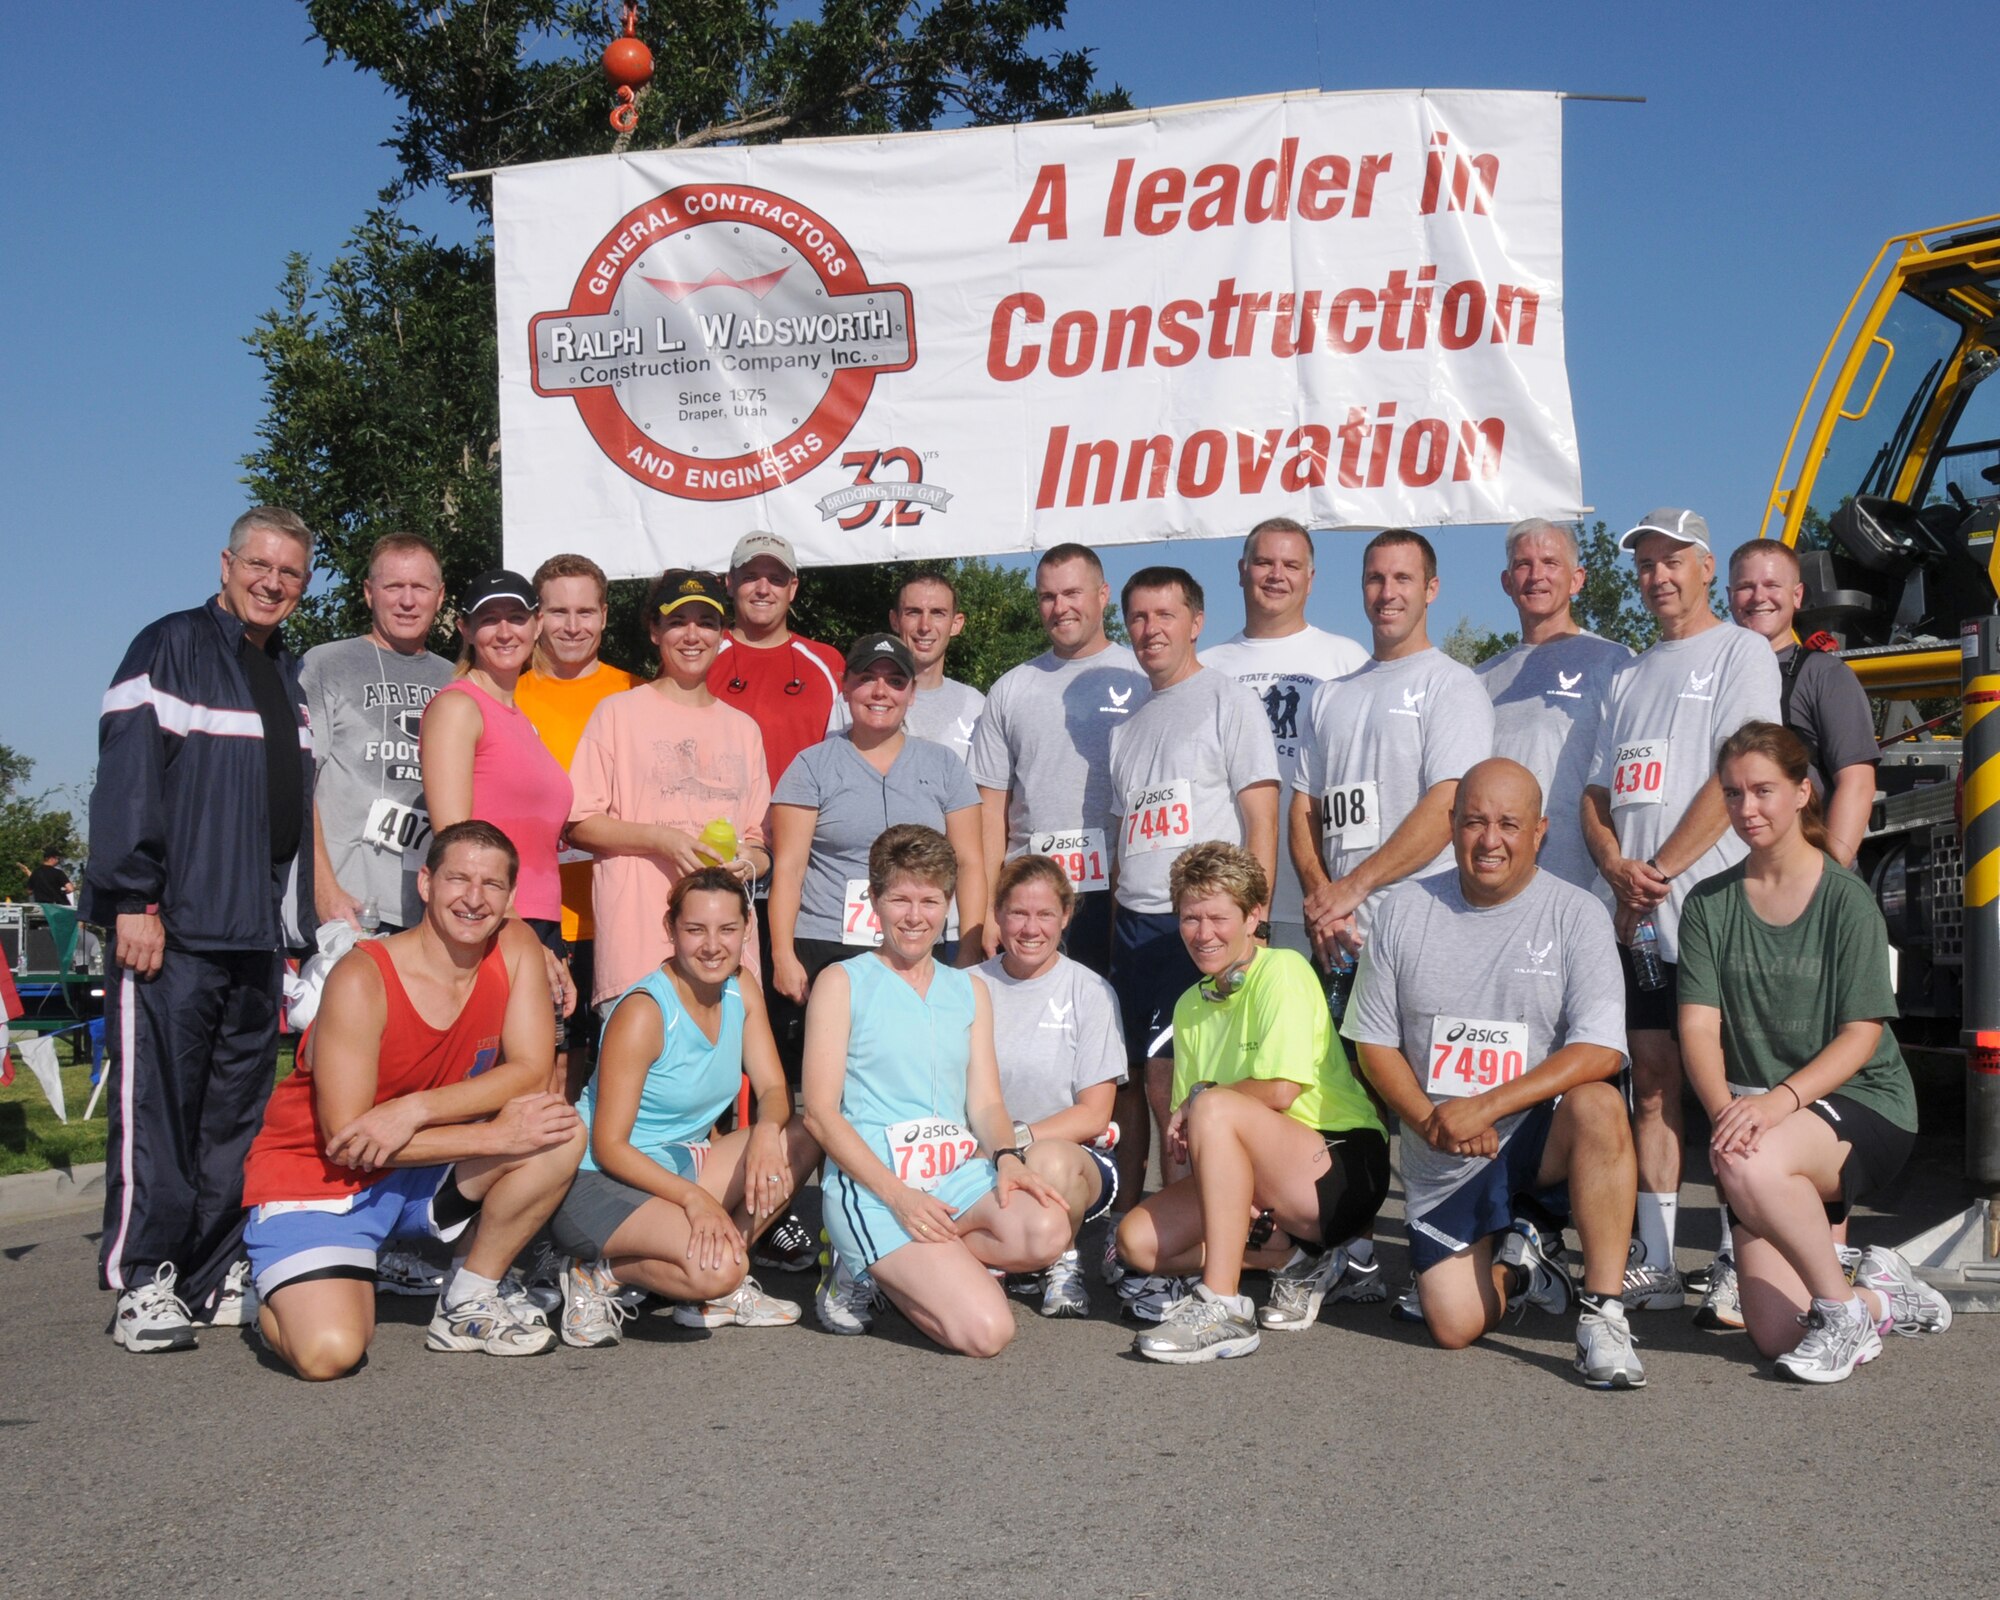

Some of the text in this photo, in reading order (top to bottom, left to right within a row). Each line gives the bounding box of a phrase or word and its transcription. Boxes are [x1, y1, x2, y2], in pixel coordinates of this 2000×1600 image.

[1008, 131, 1500, 243] A leader in
[588, 192, 847, 296] GENERAL CONTRACTORS
[550, 309, 893, 363] RALPH L. WADSWORTH
[986, 265, 1541, 382] Construction
[580, 348, 867, 384] Construction Company Inc.
[678, 404, 767, 422] Draper, Utah
[679, 388, 767, 406] Since 1975
[626, 432, 823, 489] AND ENGINEERS
[1035, 401, 1506, 510] Innovation
[825, 485, 944, 511] BRIDGING THE GAP
[837, 446, 939, 531] 32 yrs
[363, 683, 403, 710] AIR
[1238, 673, 1314, 686] STATE PRISON
[1614, 762, 1662, 795] 430
[377, 807, 432, 851] 407
[1128, 803, 1190, 845] 7443
[1432, 1043, 1522, 1086] 7490
